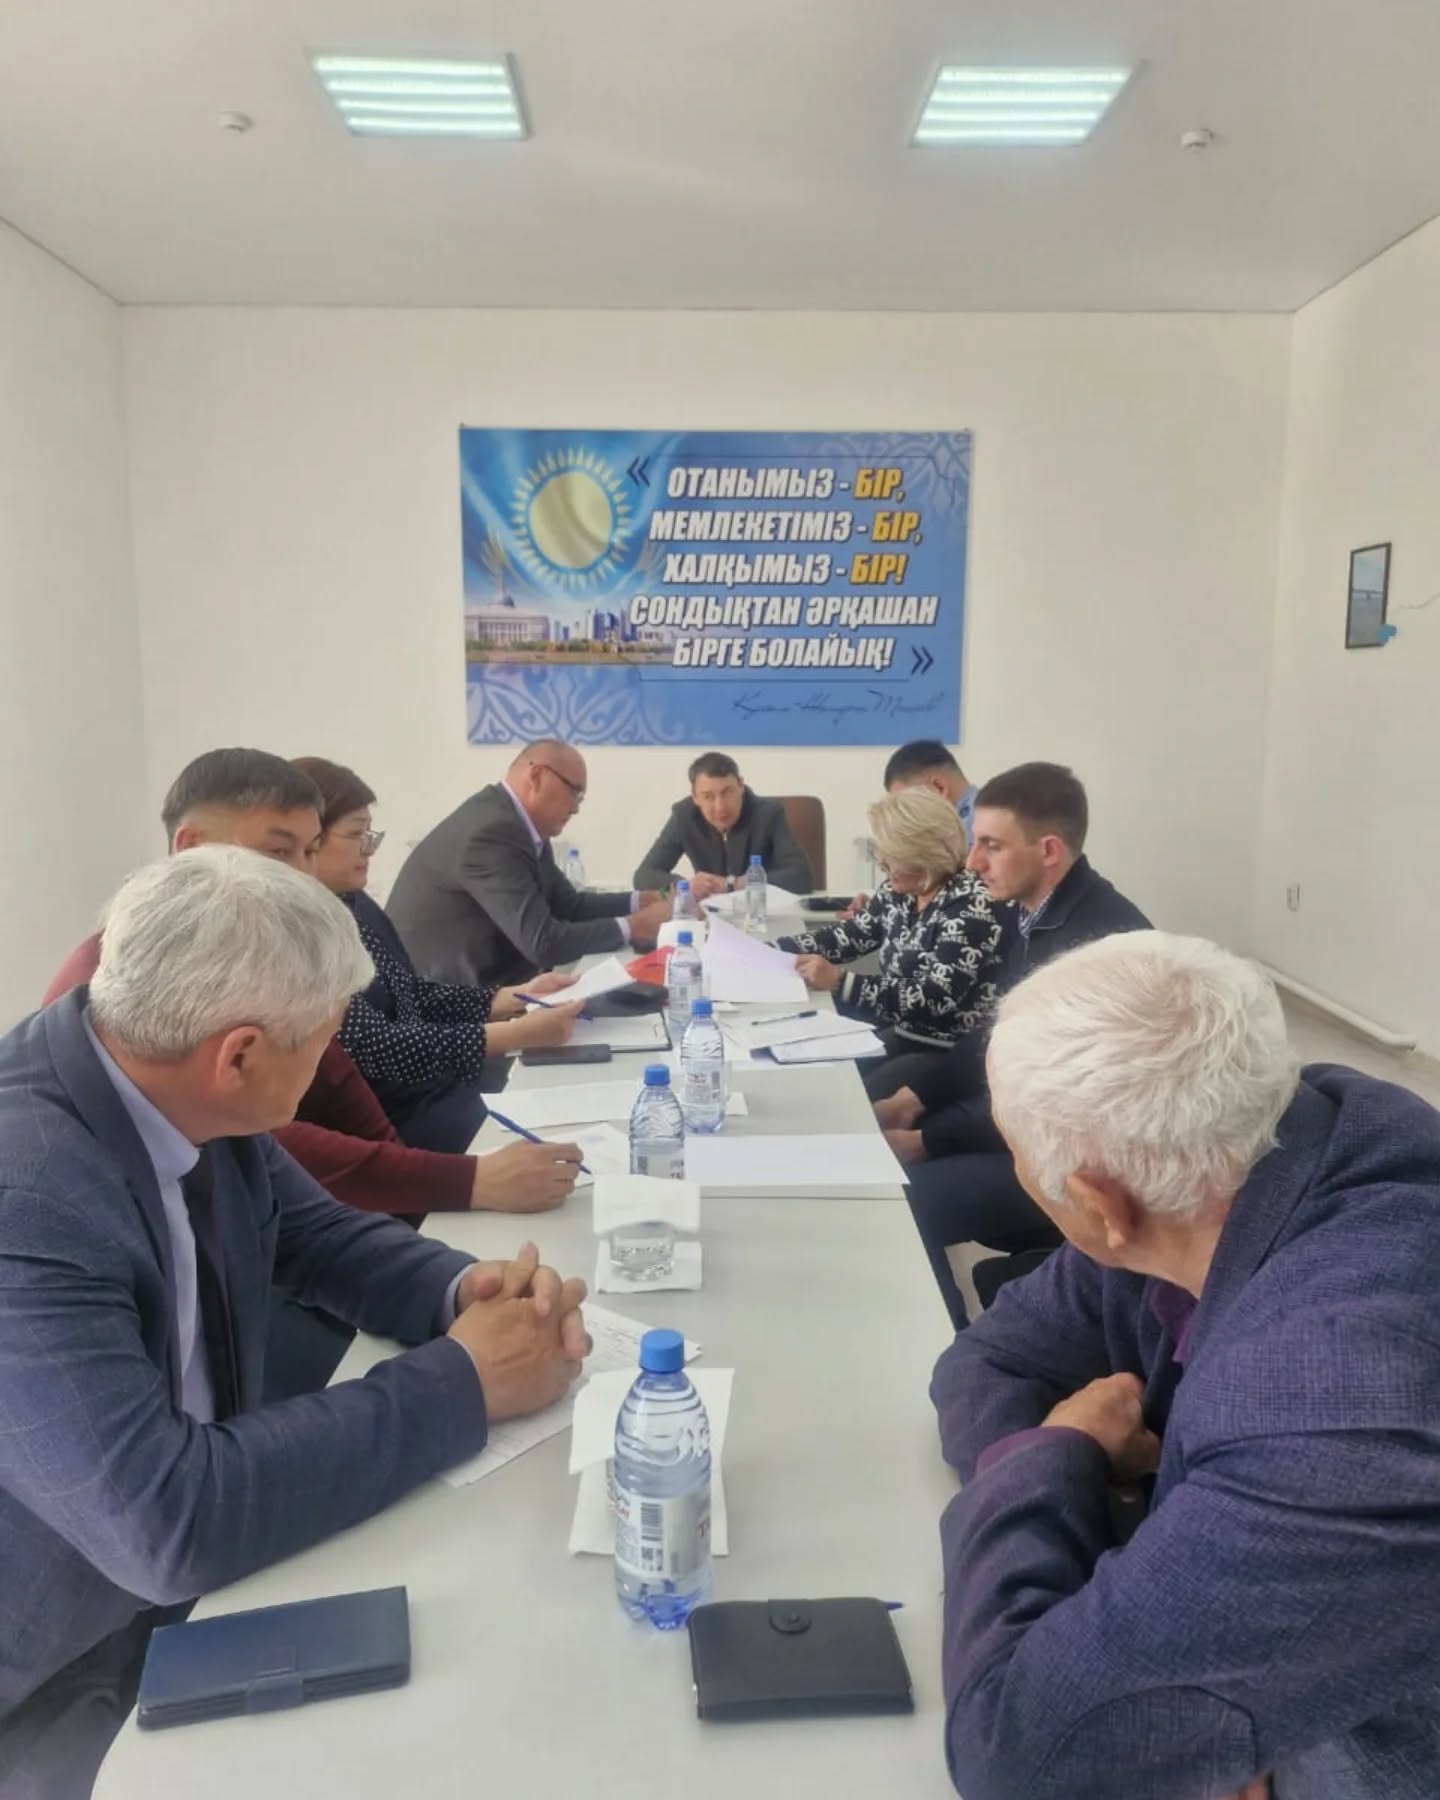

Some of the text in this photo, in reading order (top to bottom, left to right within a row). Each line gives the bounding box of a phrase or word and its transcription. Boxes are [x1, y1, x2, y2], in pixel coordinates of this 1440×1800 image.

[667, 467, 835, 499] ОТАНЫМЫЗ
[853, 468, 904, 502] БІР,
[648, 510, 853, 542] МЕМЛЕКЕТІМІЗ
[871, 511, 922, 545] БІР,
[662, 553, 832, 588] ХАЛҚЫМЫЗ
[849, 554, 908, 584] БІР!
[629, 594, 939, 630] СОНДЫҚТАН ӘРҚАШАН
[672, 637, 746, 667] БІРГЕ
[748, 632, 894, 671] БОЛАЙЫҚ!
